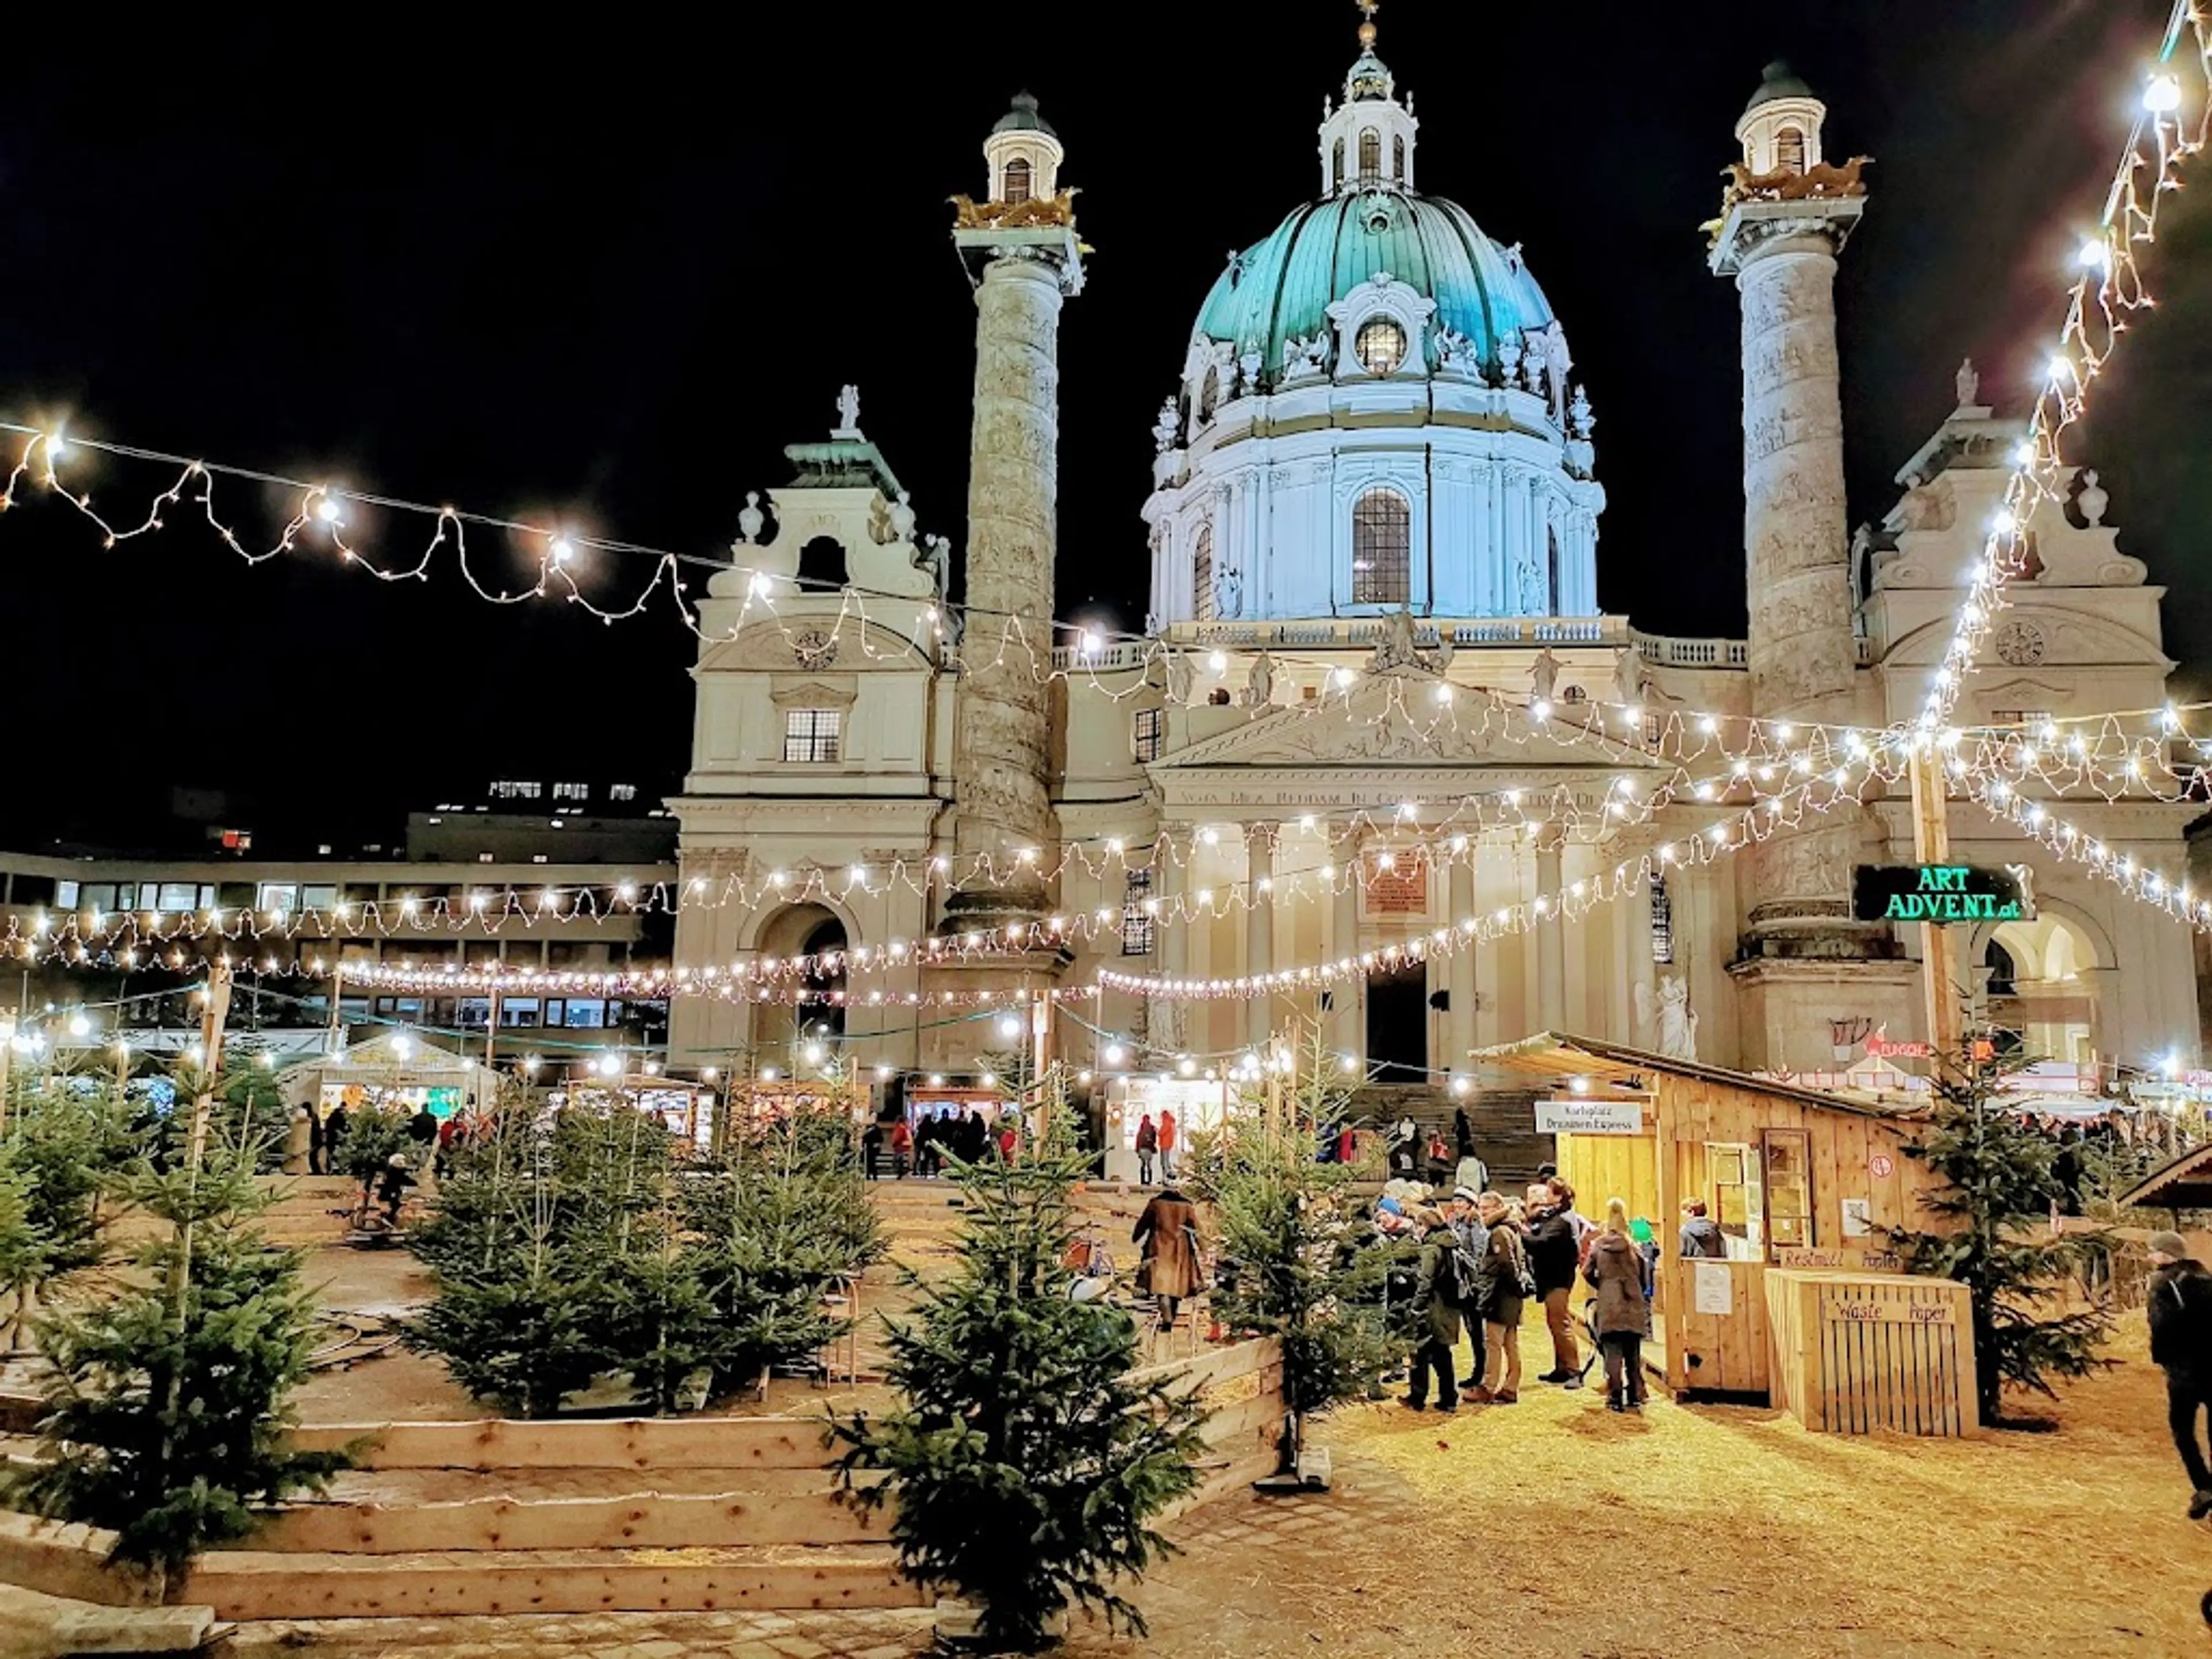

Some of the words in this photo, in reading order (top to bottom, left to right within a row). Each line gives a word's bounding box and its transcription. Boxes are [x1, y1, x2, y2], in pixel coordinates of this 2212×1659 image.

[1352, 793, 1366, 805] IN
[1916, 868, 1969, 891] ART
[1836, 1301, 1884, 1319] Waste
[1908, 1302, 1947, 1326] Paper
